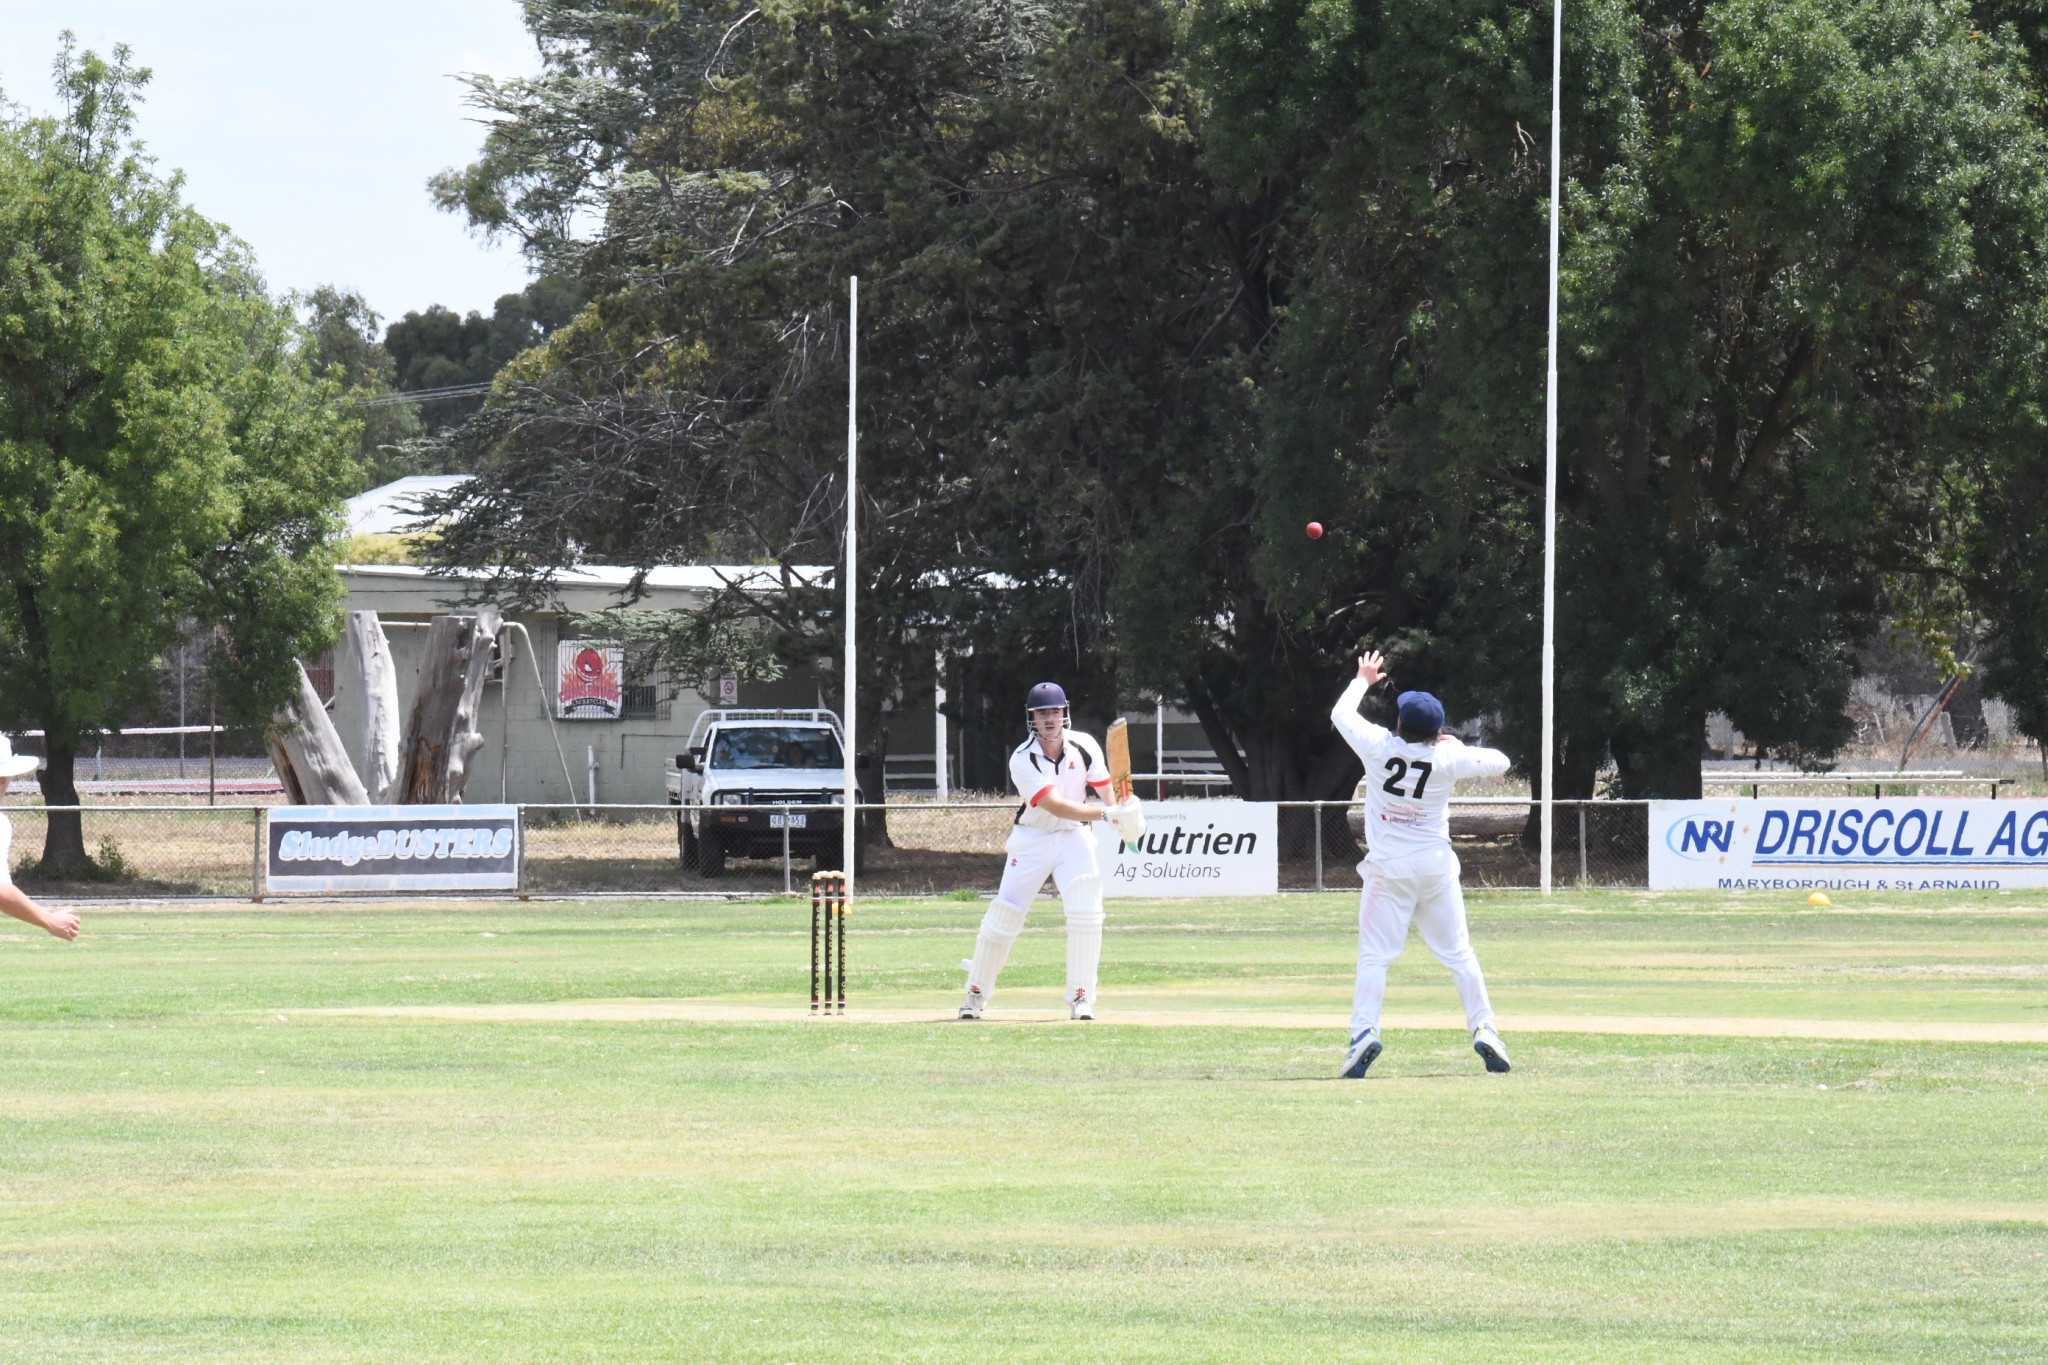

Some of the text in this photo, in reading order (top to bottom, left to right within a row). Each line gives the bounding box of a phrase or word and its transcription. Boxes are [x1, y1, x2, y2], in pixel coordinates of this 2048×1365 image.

[1383, 757, 1432, 799] 27
[1178, 813, 1186, 821] by
[1755, 808, 1974, 856] DRISCOLL
[279, 828, 513, 867] SludgeBUSTERS
[1114, 862, 1221, 881] Ag Solutions
[1718, 878, 2000, 890] MARYBOROUGH & St ARNAUD
